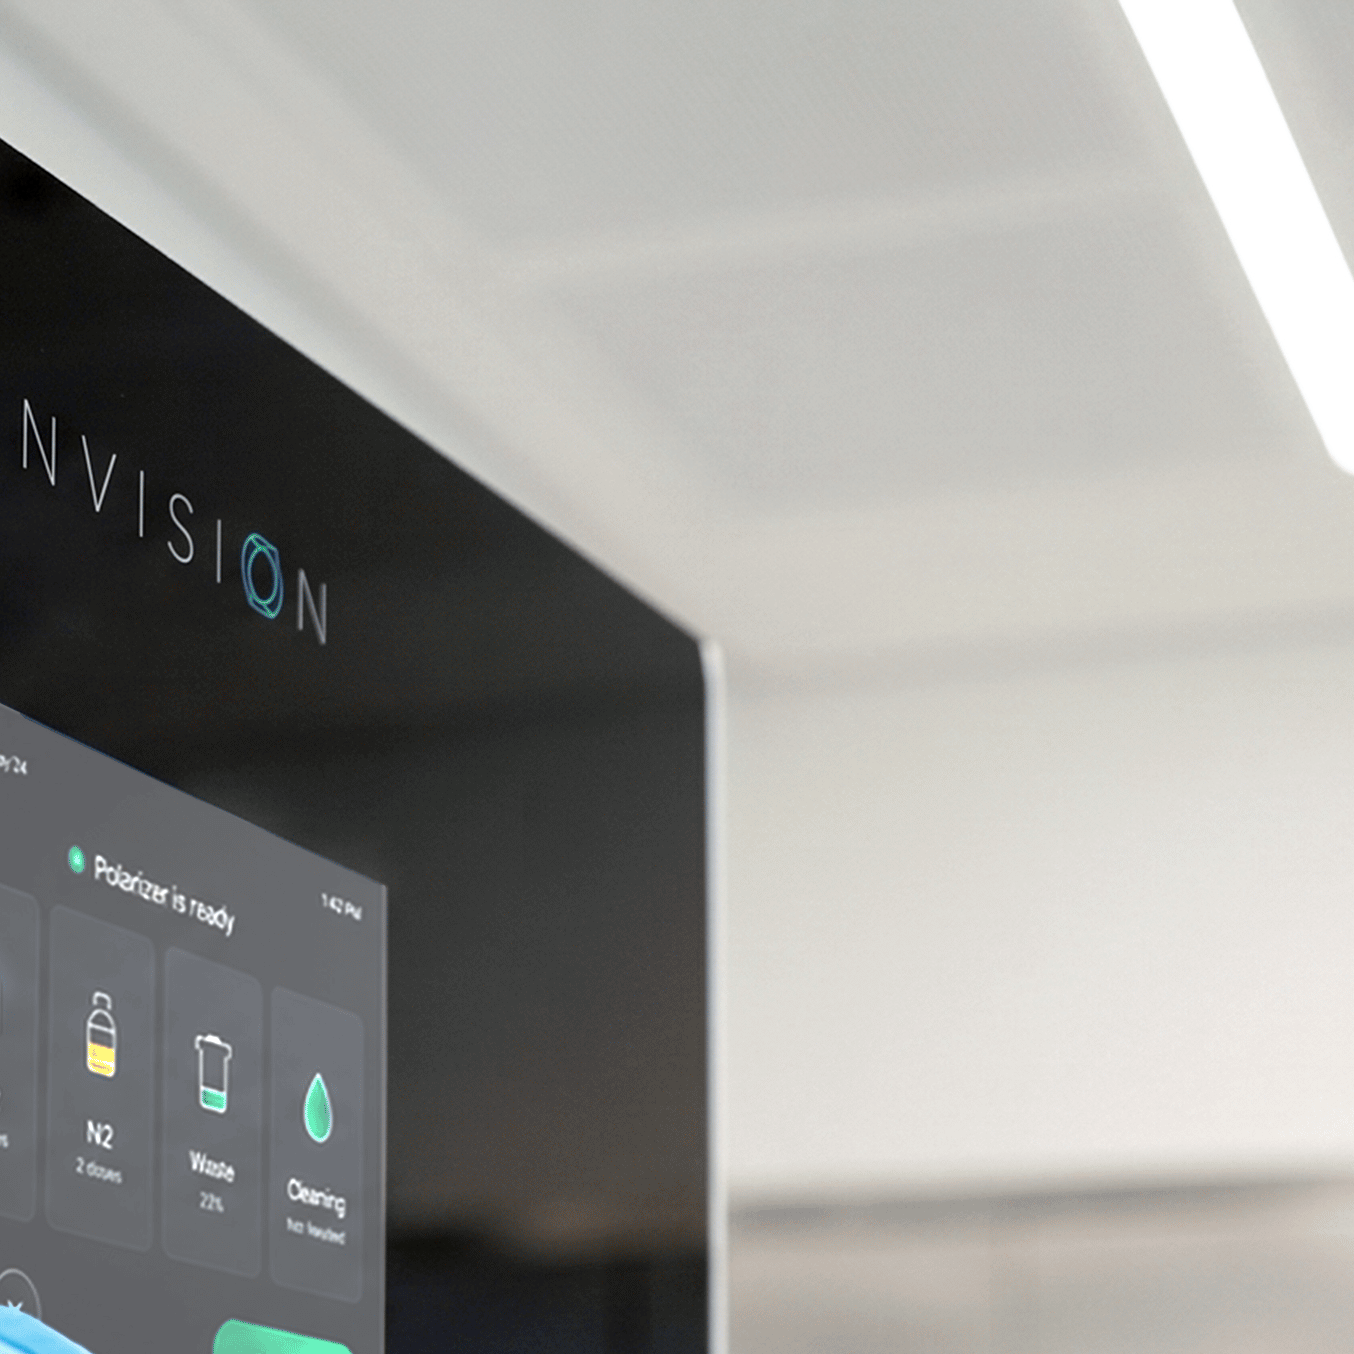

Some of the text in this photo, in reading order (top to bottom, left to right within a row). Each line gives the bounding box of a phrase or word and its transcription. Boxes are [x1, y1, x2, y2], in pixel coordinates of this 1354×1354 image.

[21, 398, 327, 645] NVISION
[94, 855, 235, 937] Polarizer is ready
[87, 1119, 114, 1149] N2
[76, 1156, 85, 1175] 2
[188, 1149, 236, 1184] Waste
[287, 1177, 346, 1219] Cleaning
